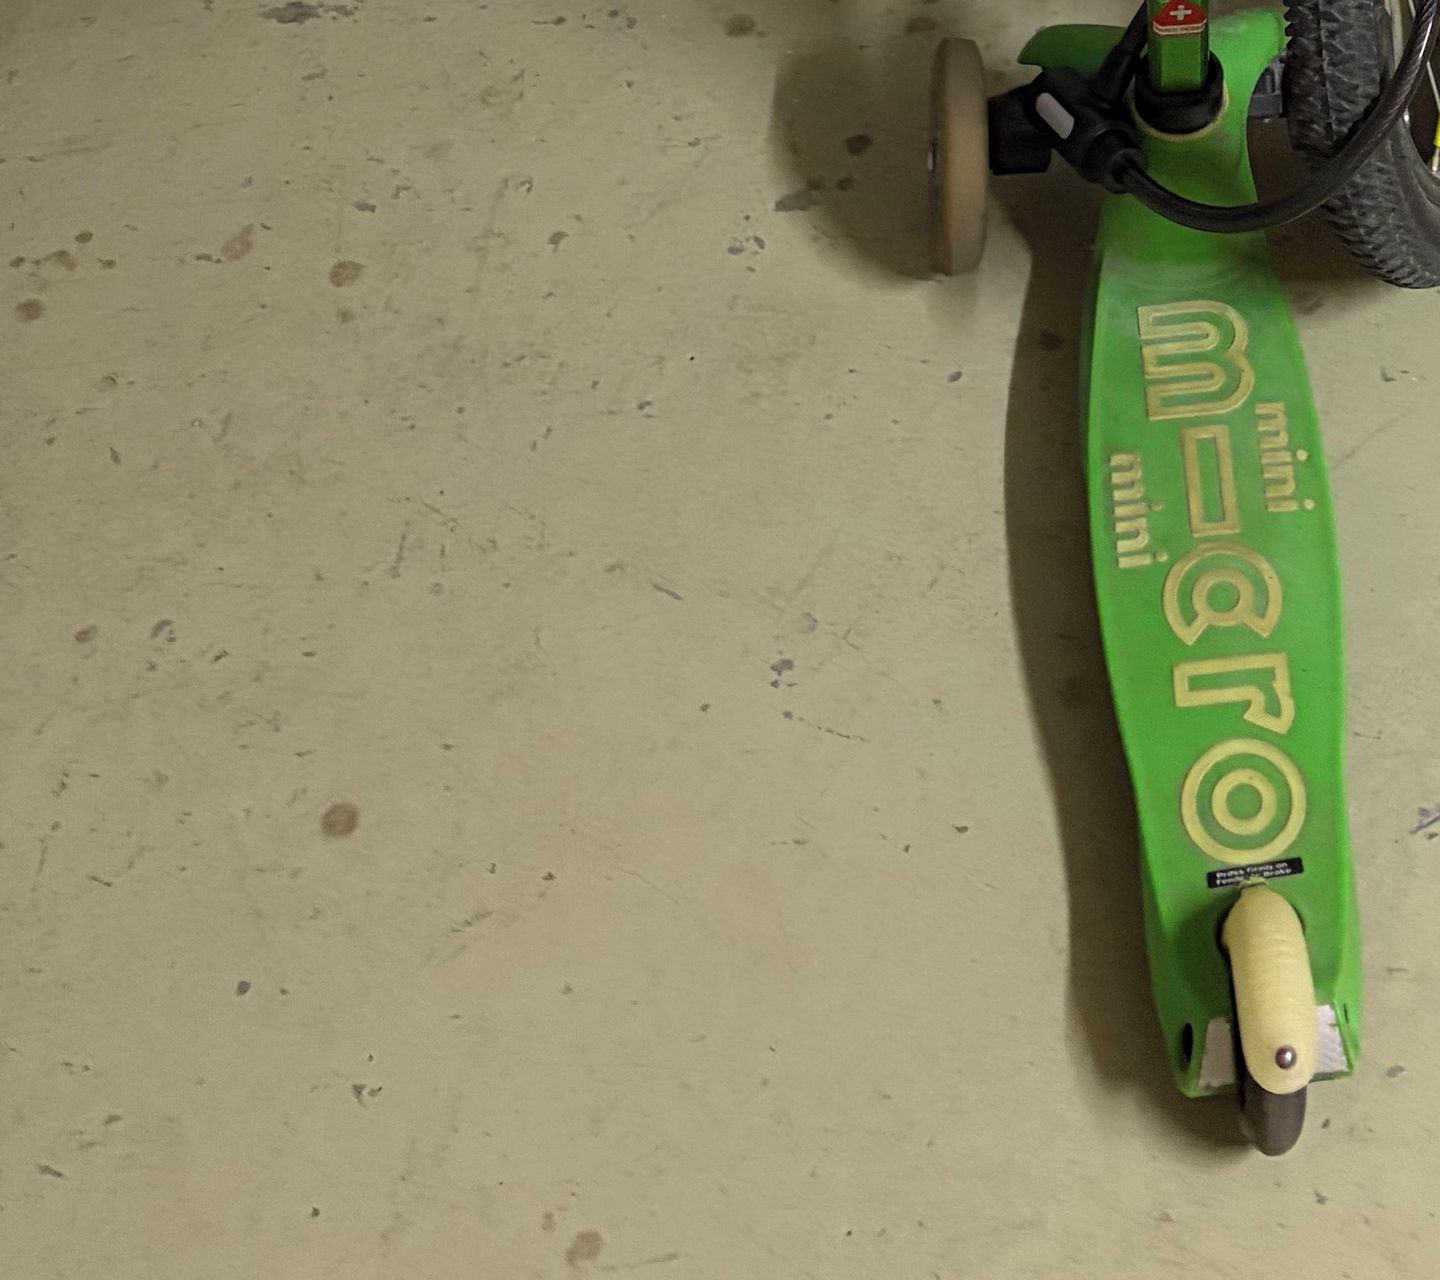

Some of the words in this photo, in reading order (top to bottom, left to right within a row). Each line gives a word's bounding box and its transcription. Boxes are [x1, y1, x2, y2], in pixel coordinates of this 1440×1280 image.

[1108, 451, 1169, 569] mini
[1253, 401, 1316, 514] mini
[1137, 300, 1307, 862] micro
